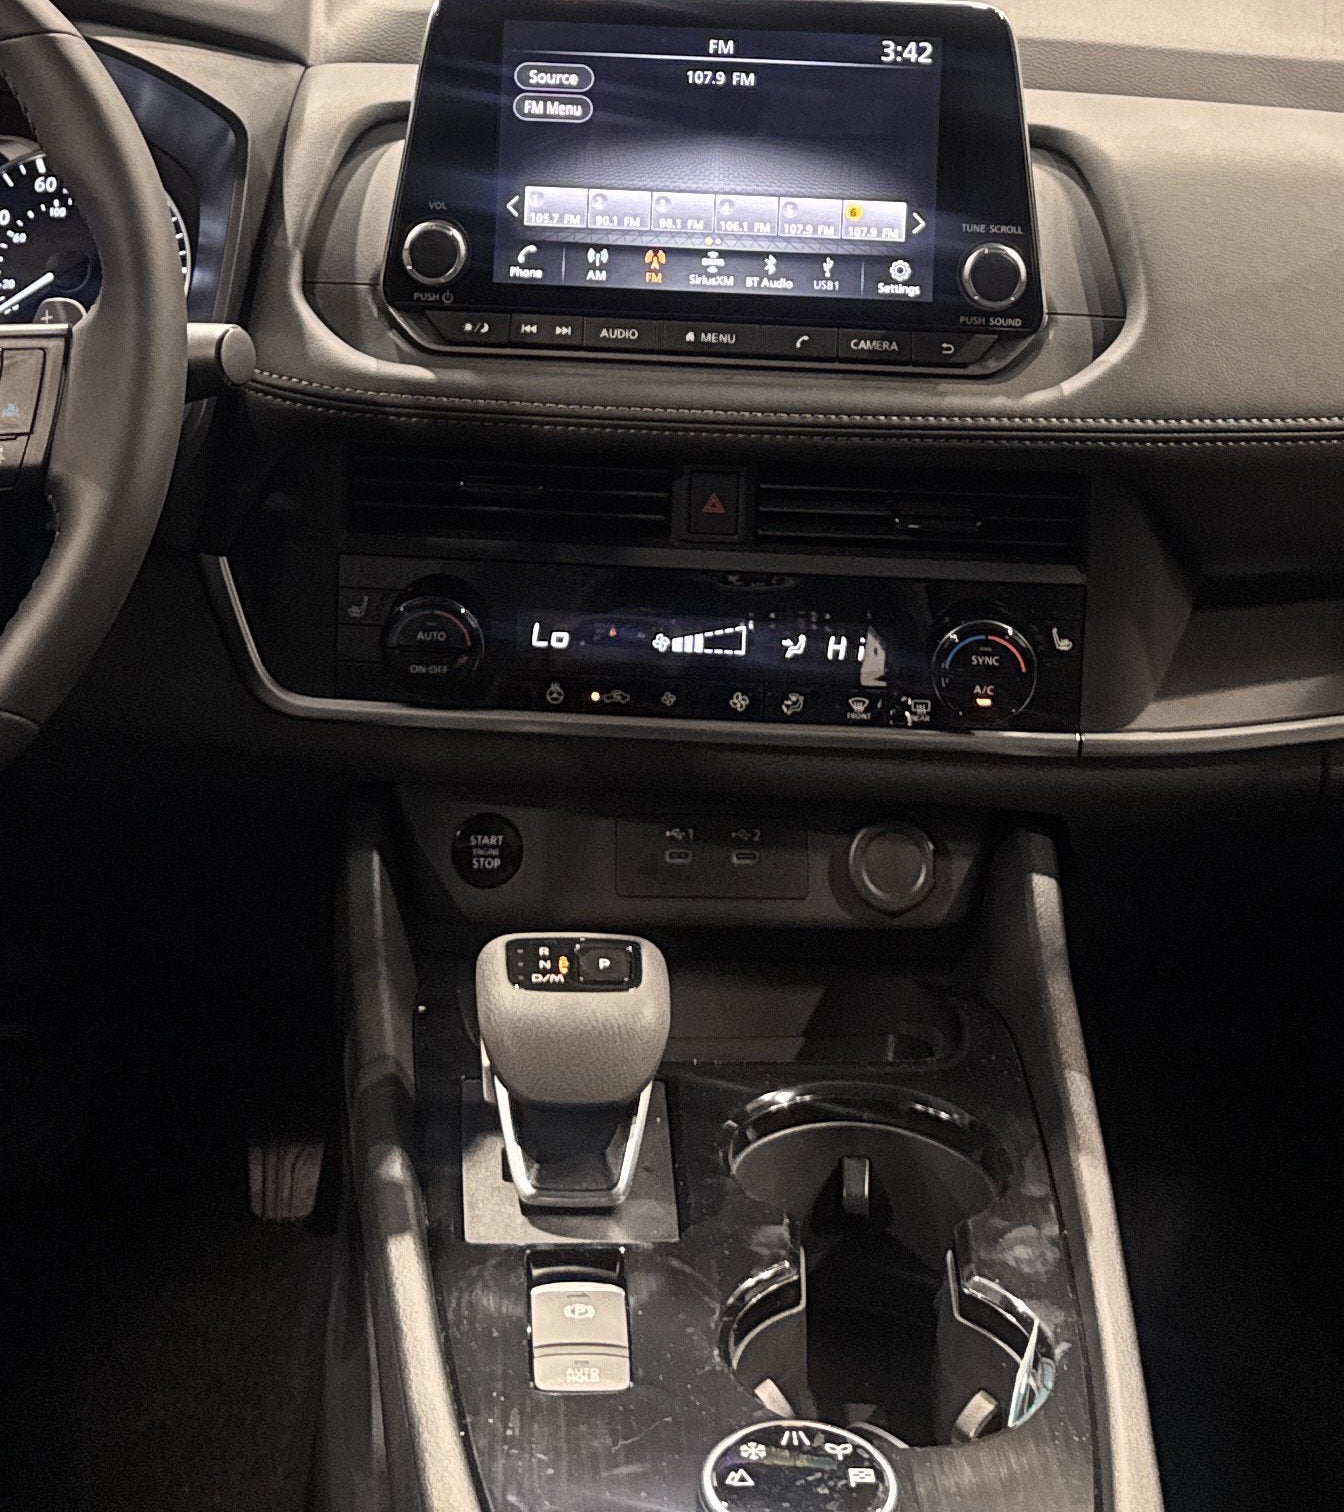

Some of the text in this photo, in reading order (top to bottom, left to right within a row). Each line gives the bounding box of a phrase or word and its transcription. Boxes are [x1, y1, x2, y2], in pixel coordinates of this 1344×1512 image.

[708, 39, 734, 55] FM
[880, 40, 933, 64] 3:42
[528, 69, 579, 86] Source
[686, 70, 755, 86] 107.9 FM
[523, 99, 583, 116] FM Menu
[34, 175, 58, 193] 60
[428, 201, 448, 210] VOL
[49, 206, 67, 218] 100
[564, 213, 581, 225] FM
[624, 216, 641, 228] FM
[687, 219, 705, 230] FM
[754, 221, 771, 233] FM
[818, 225, 835, 236] FM
[989, 224, 1024, 235] SCROLL
[12, 232, 27, 244] 60
[881, 228, 900, 239] FM
[509, 266, 543, 280] Phone
[586, 270, 607, 282] AM
[645, 272, 663, 284] FM
[1, 278, 16, 290] 20
[688, 273, 735, 287] SiriusXM
[745, 277, 794, 290] BT Audio
[813, 279, 840, 292] USB1
[413, 291, 440, 301] PUSH
[877, 282, 921, 298] Settings
[959, 315, 1022, 327] PUSH SOUND
[600, 327, 639, 340] AUDIO
[700, 332, 737, 345] MENU
[850, 339, 899, 352] CAMERA
[416, 631, 447, 642] AUTO
[531, 621, 570, 649] Lo
[826, 635, 866, 662] Hi
[971, 655, 1000, 667] SYNC
[973, 685, 995, 696] A/C
[847, 712, 872, 721] FRONT
[911, 714, 931, 723] REAR
[470, 834, 503, 846] START
[472, 857, 502, 869] STOP
[538, 946, 550, 957] R
[538, 959, 552, 970] N
[598, 957, 611, 970] P
[531, 973, 565, 984] D/M
[565, 1367, 600, 1376] AUTO
[566, 1374, 600, 1384] HOLD
